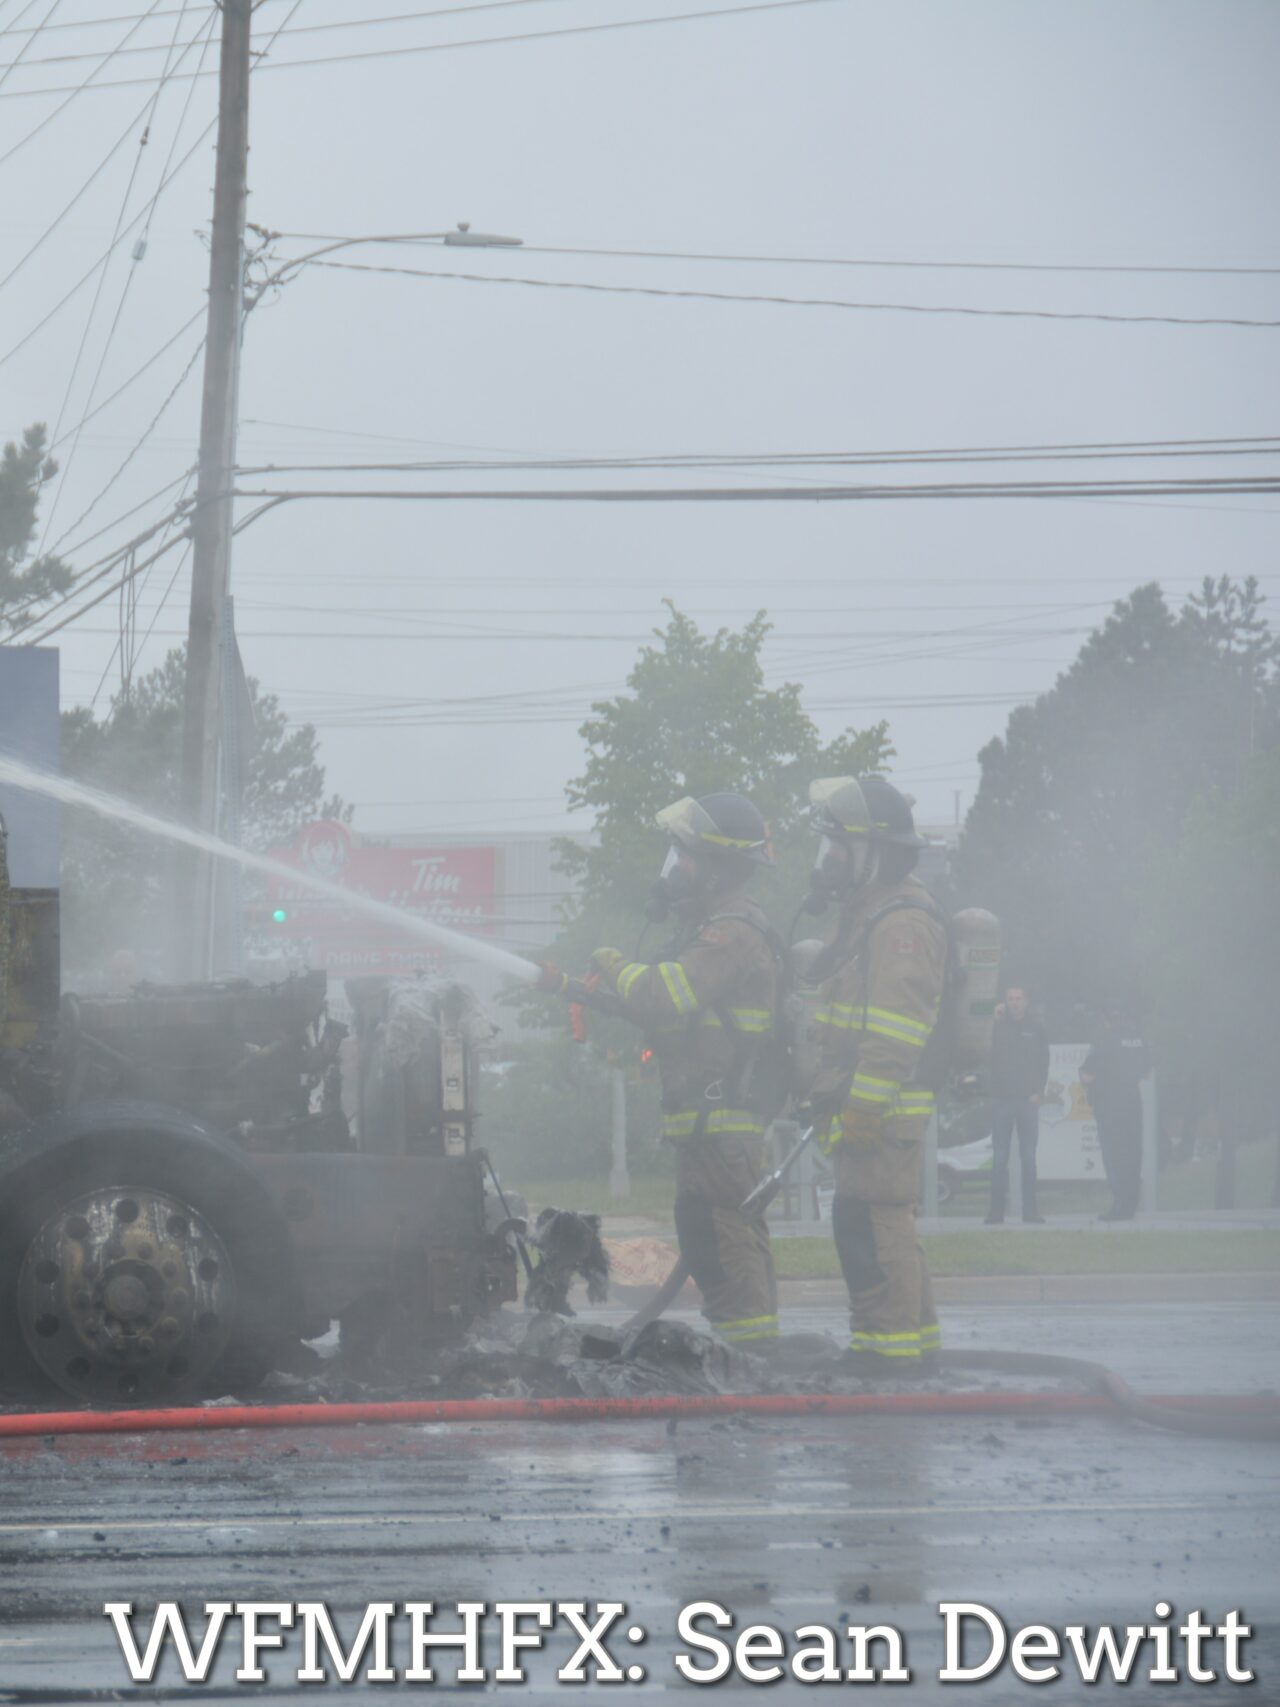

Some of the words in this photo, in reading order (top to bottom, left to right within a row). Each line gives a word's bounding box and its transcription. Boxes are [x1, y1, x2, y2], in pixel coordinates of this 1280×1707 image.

[411, 855, 462, 893] Tim
[326, 951, 381, 966] DRIVE
[385, 951, 442, 968] THRU
